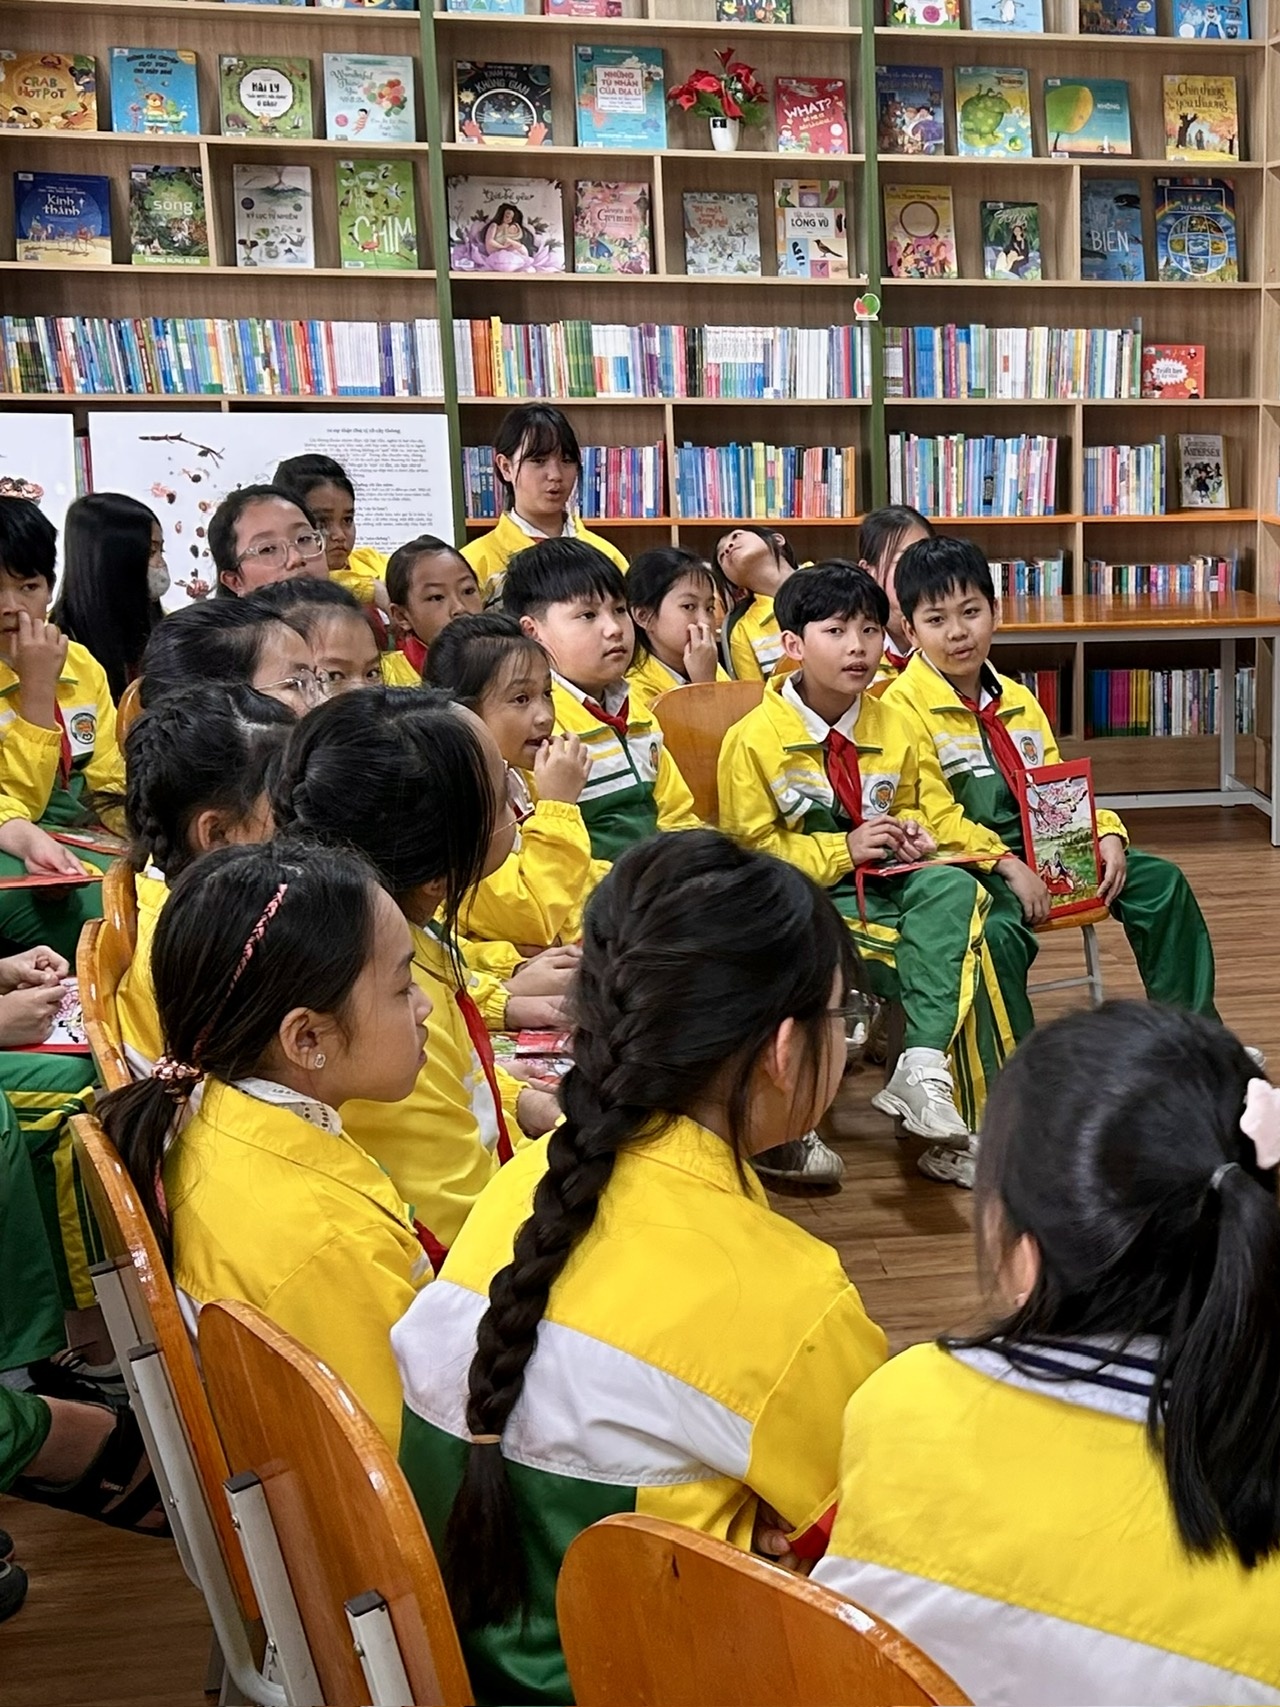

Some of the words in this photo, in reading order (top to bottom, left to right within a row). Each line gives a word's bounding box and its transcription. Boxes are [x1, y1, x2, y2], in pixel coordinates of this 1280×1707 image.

[22, 76, 58, 88] CRAB
[783, 98, 832, 119] WHAT?
[47, 193, 74, 206] Kinh
[353, 216, 413, 254] CHIM
